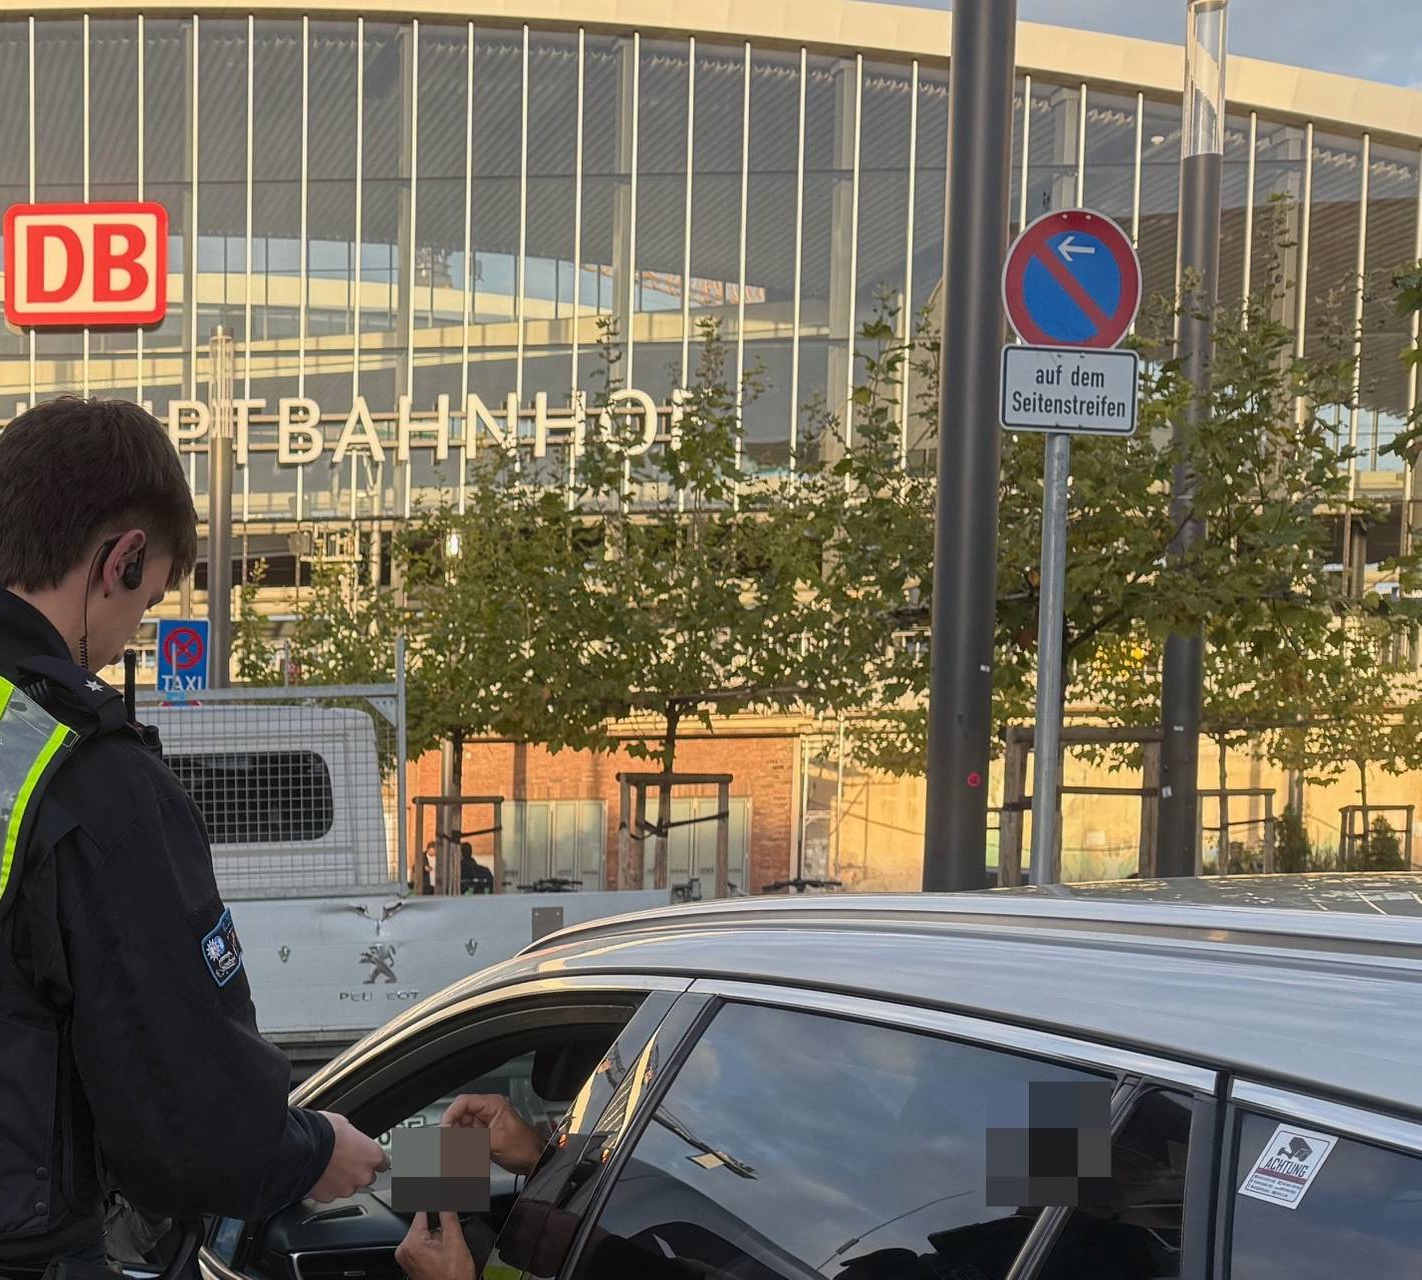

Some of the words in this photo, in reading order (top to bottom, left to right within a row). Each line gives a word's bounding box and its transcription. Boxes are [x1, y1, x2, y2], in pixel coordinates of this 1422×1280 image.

[26, 223, 149, 304] DB
[1035, 364, 1062, 386] auf
[1071, 365, 1104, 388] dem
[1012, 390, 1126, 418] Seitenstreifen
[161, 675, 203, 691] TAXI
[339, 991, 420, 1002] PEUEOT
[1264, 1157, 1309, 1178] ACHTUNG
